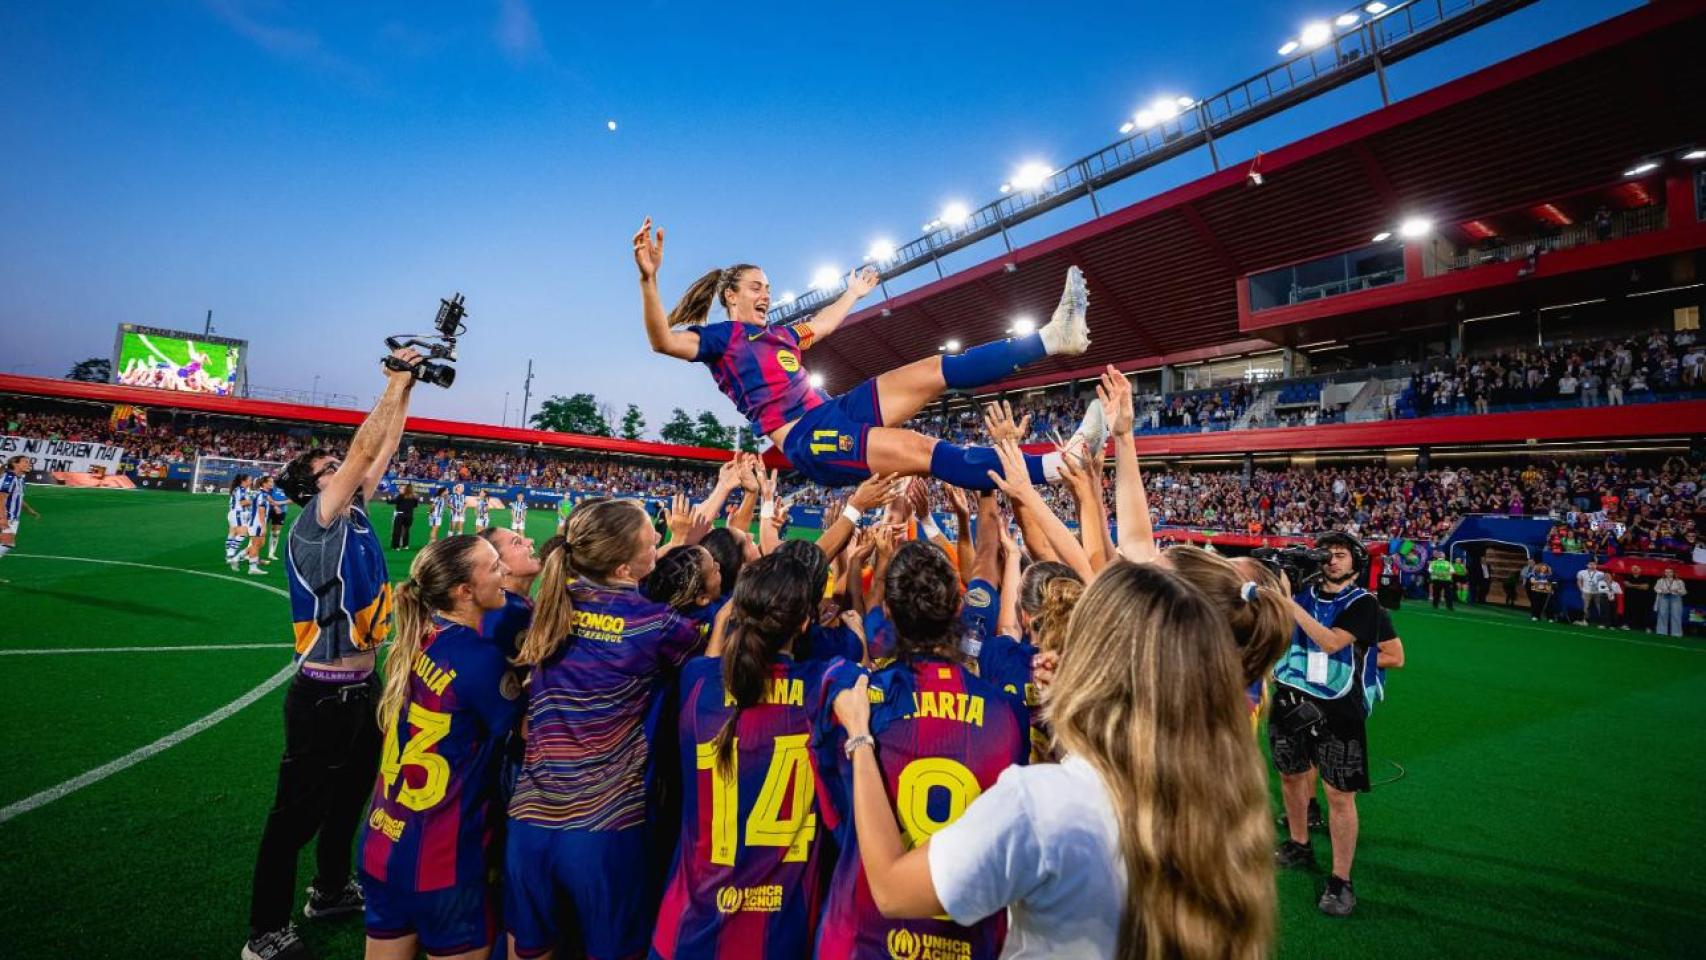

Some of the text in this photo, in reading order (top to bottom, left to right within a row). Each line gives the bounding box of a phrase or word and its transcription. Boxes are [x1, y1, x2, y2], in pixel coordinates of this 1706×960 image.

[810, 430, 839, 455] 11
[903, 691, 985, 728] ARTA
[696, 733, 816, 867] 14
[922, 933, 972, 955] UNHCR
